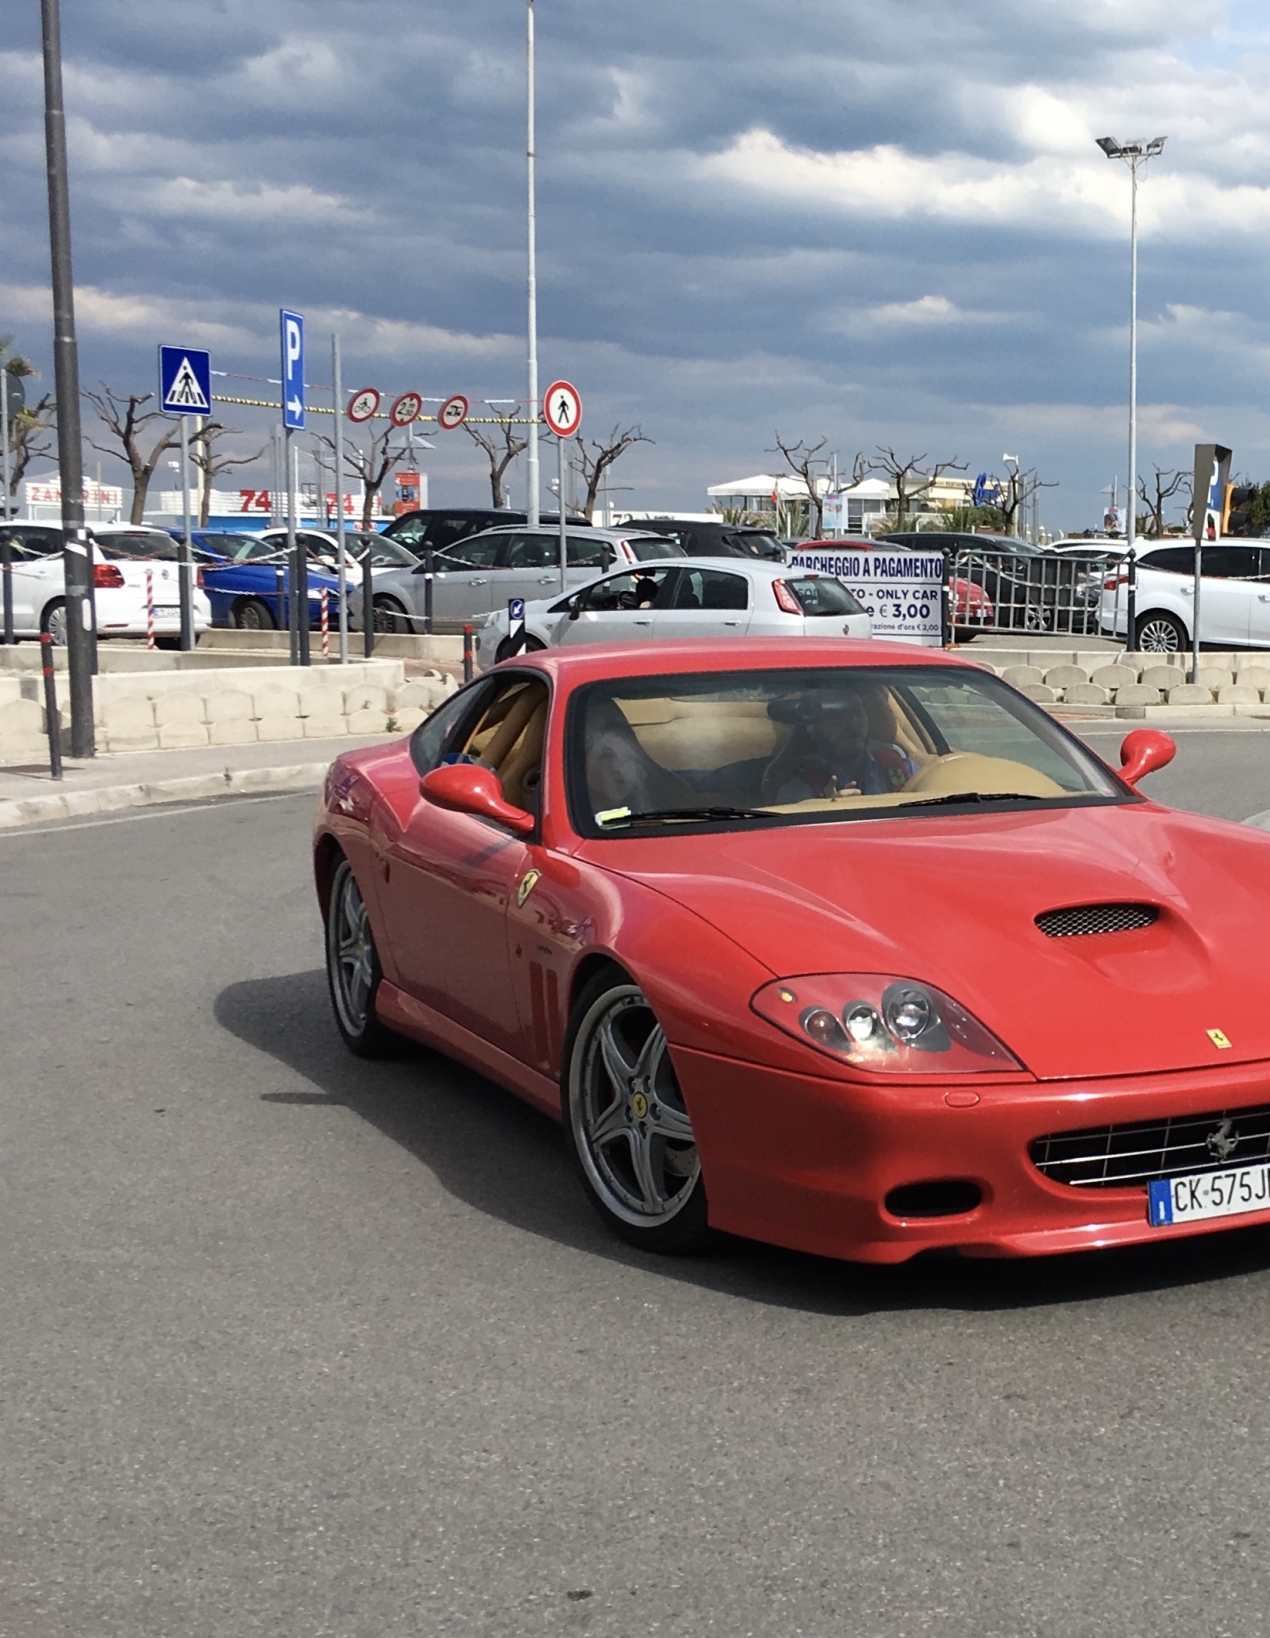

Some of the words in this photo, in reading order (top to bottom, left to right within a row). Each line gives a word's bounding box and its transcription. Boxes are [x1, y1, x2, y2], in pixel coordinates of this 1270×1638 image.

[286, 319, 300, 381] P
[240, 489, 272, 512] 74
[792, 556, 860, 577] PARCHEGGIO
[862, 557, 871, 577] A
[873, 557, 942, 578] PAGAMENTO
[876, 589, 909, 600] ONLY
[912, 590, 938, 600] CAR
[879, 604, 888, 618] €
[892, 603, 931, 621] 3,00
[897, 623, 915, 631] d'ora
[922, 624, 939, 632] 2,00
[1158, 1201, 1165, 1220] I
